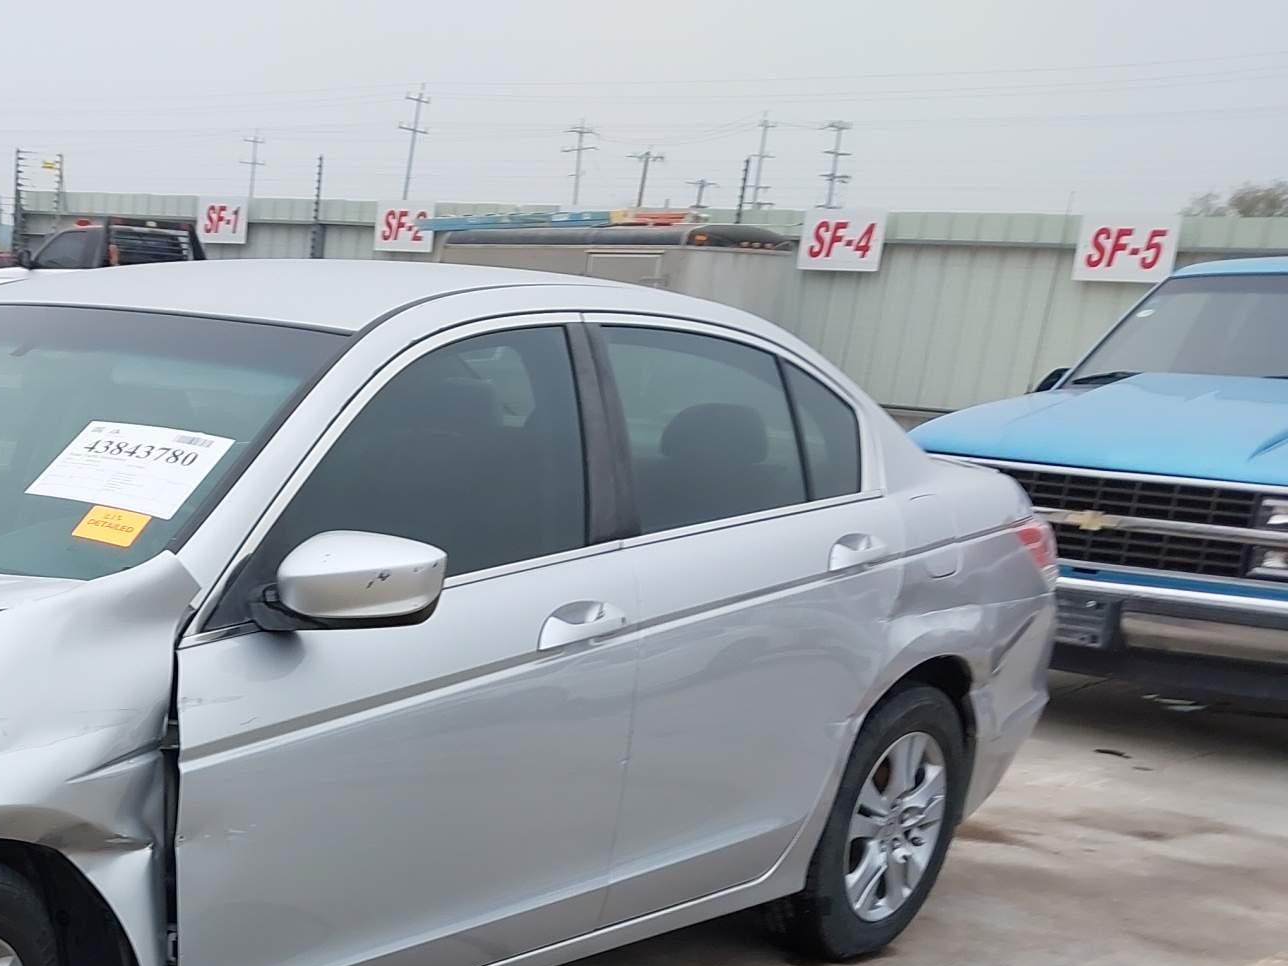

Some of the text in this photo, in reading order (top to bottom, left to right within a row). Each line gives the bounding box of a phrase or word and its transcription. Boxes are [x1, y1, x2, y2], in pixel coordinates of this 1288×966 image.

[204, 205, 241, 234] SF-1
[807, 220, 877, 258] SF-4
[1084, 226, 1169, 270] SF-5
[83, 439, 200, 467] 43843780
